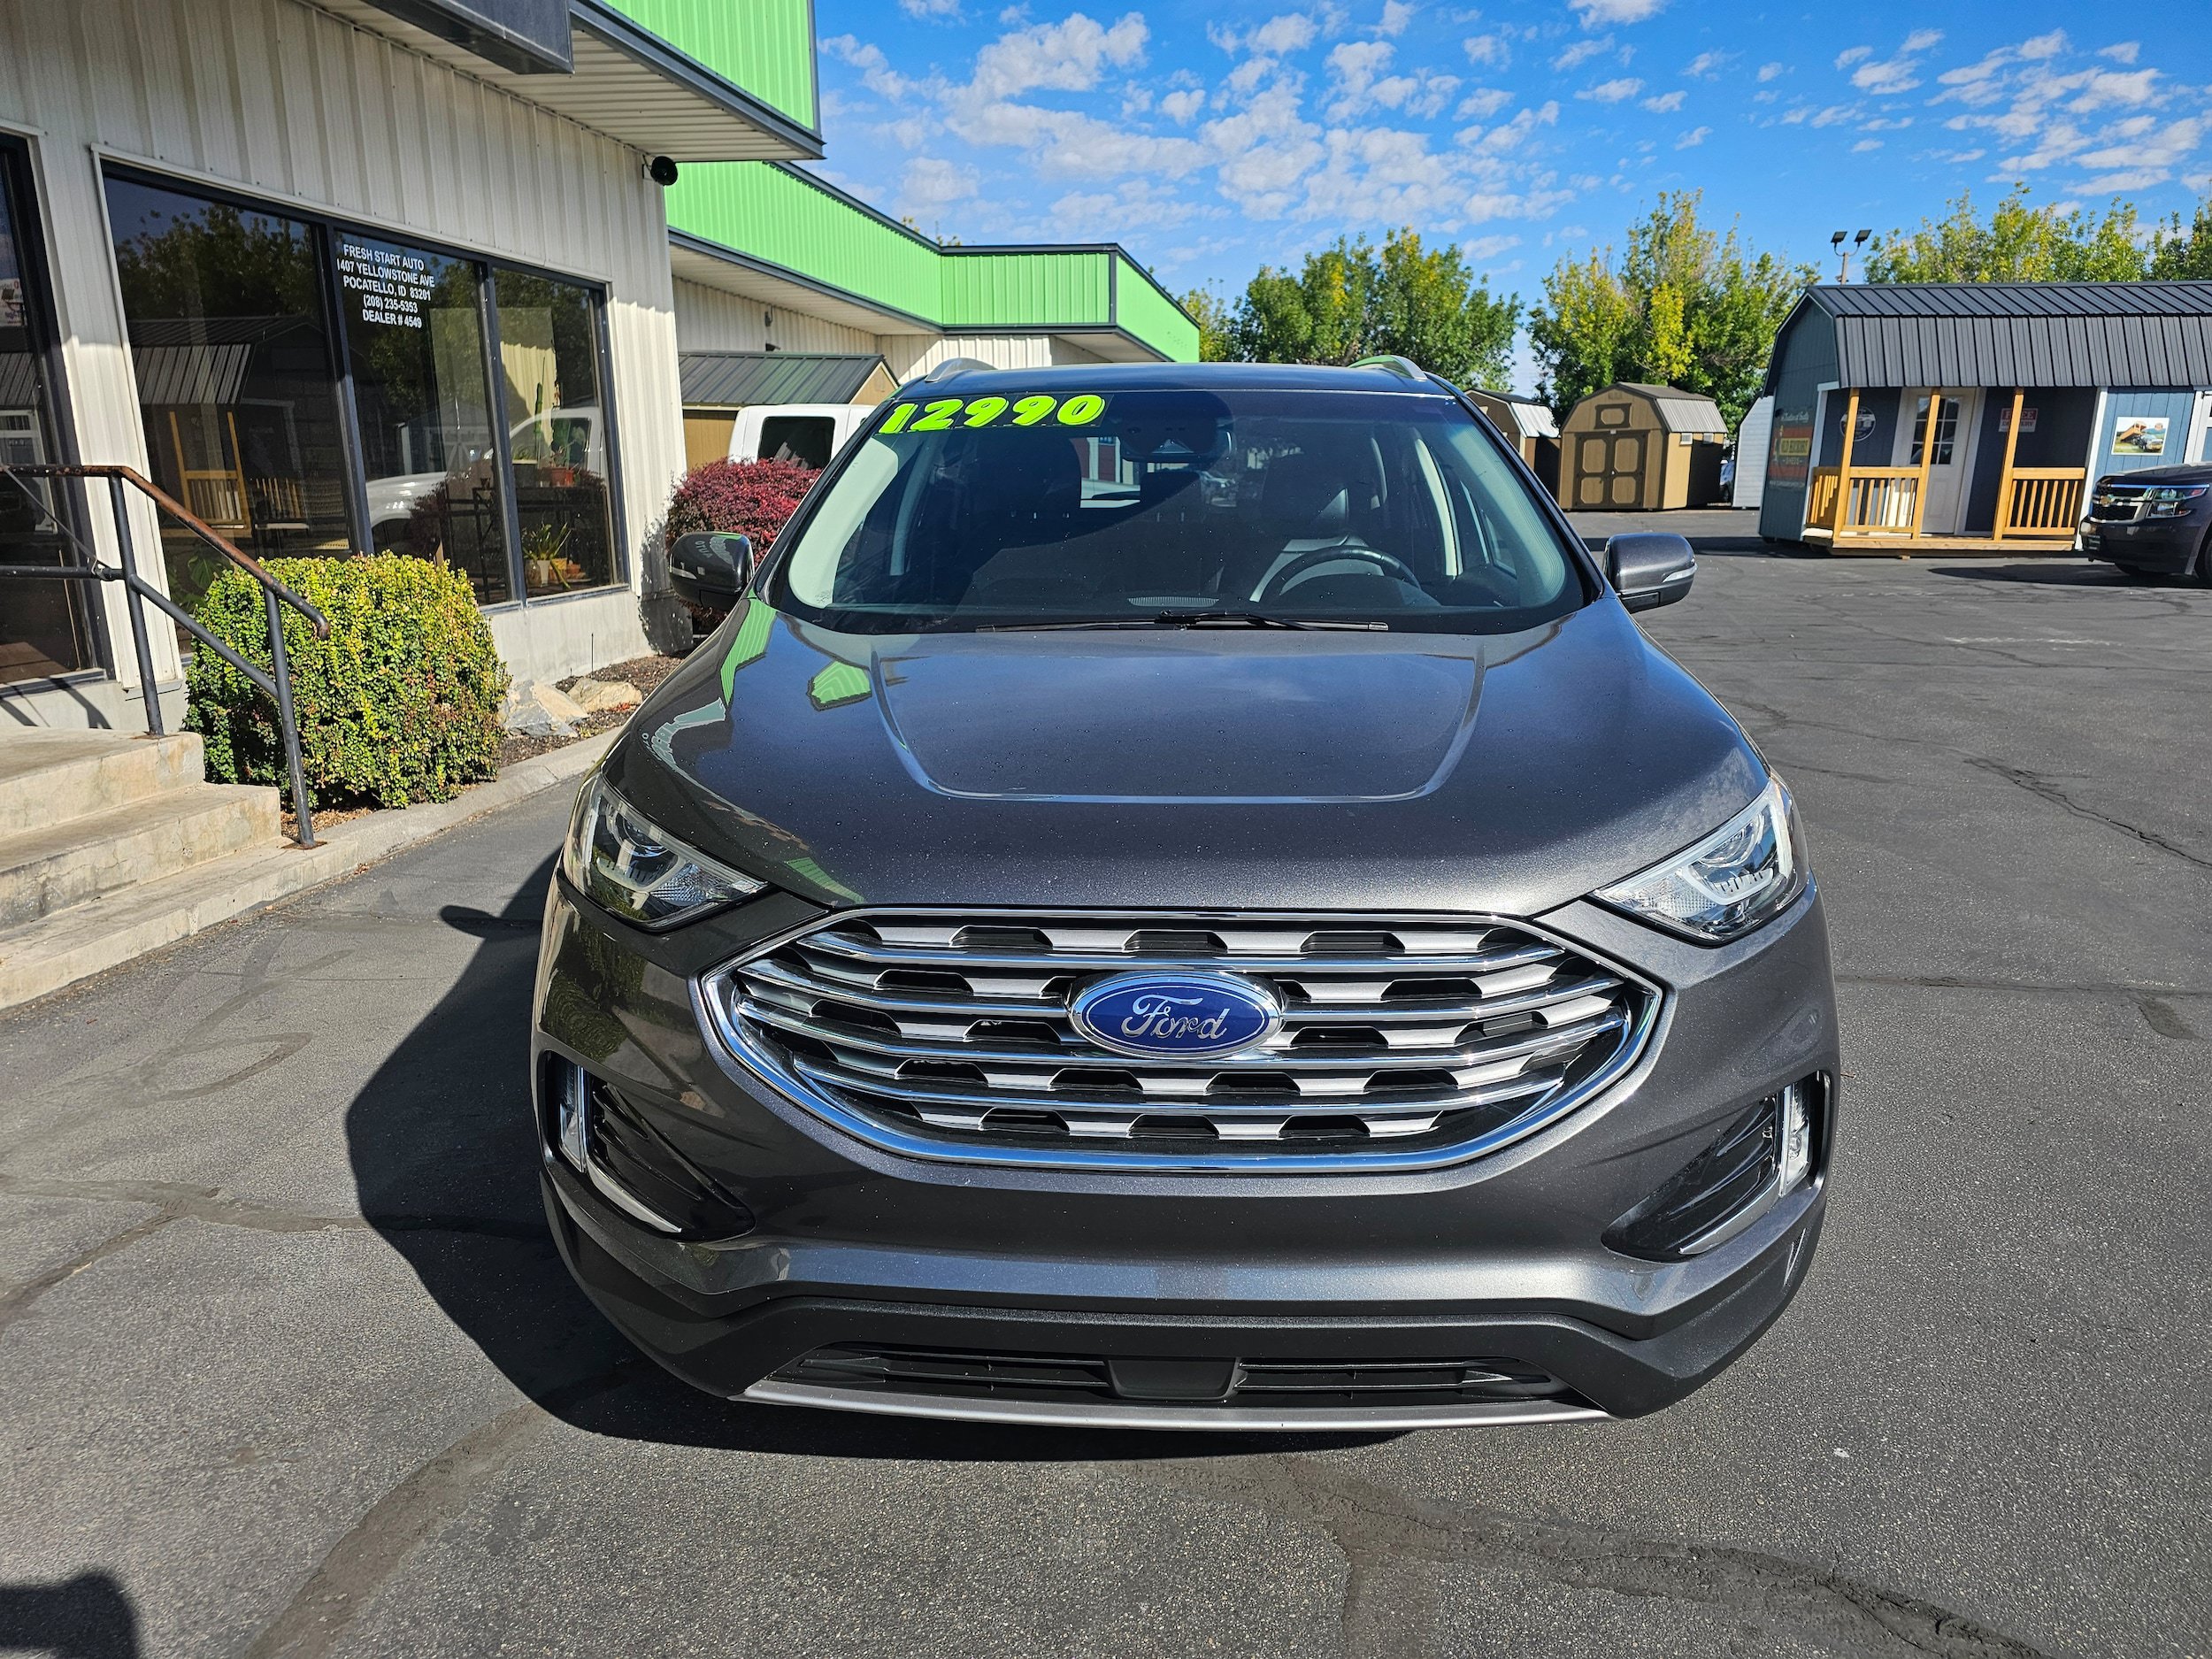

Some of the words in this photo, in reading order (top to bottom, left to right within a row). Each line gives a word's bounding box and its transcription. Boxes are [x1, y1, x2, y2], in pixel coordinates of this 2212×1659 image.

[343, 244, 373, 261] FRESH
[374, 250, 400, 266] START
[403, 257, 425, 271] AUTO
[337, 258, 355, 273] 1407
[356, 262, 419, 285] YELLOWSTONE
[419, 274, 435, 288] AVE
[343, 275, 397, 297] POCATELLO,
[398, 284, 407, 297] ID
[410, 287, 431, 301] 83201
[363, 294, 383, 311] (208)
[384, 297, 419, 314] 235-5353
[363, 309, 397, 325] DEALER
[397, 314, 403, 326] #
[404, 315, 422, 328] 4549
[878, 395, 1105, 434] 12990
[1120, 994, 1231, 1040] Ford
